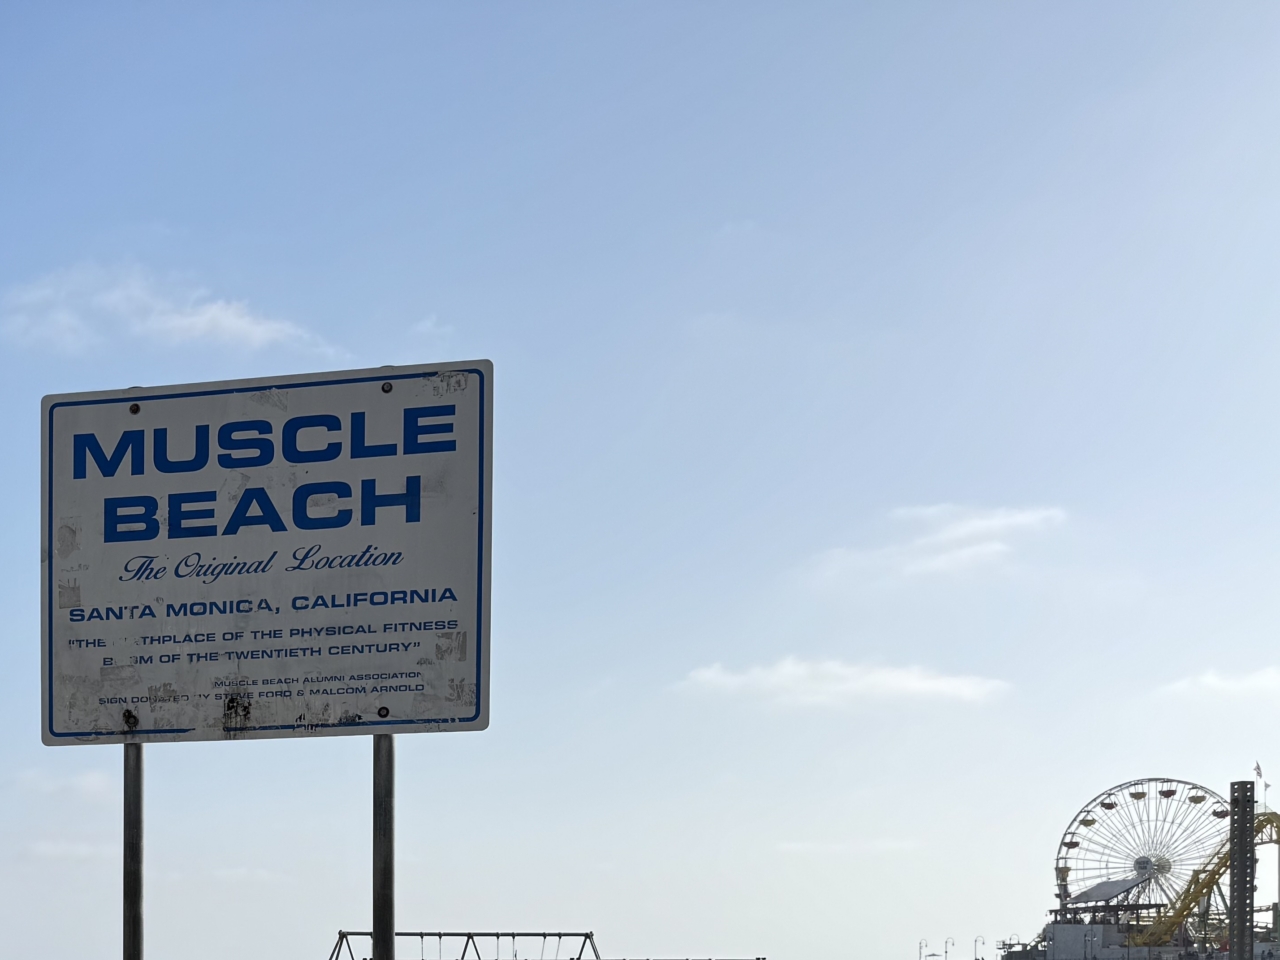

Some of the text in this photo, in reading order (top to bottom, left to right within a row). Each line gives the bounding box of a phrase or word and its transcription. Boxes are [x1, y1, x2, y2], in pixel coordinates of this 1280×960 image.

[73, 404, 456, 479] MUSCLE
[104, 475, 420, 543] BEACH
[119, 544, 404, 584] The Original Location
[69, 588, 458, 622] SANTA MONICA, CALIFORNIA
[112, 632, 216, 647] THPLACE
[222, 631, 245, 642] OF
[250, 629, 283, 640] THE
[289, 625, 377, 638] PHYSICAL
[383, 620, 458, 633] FITNESS
[159, 653, 181, 664] OF
[186, 651, 219, 663] THE
[224, 647, 322, 661] TWENTIETH
[98, 696, 127, 705] SIGN
[215, 691, 254, 700] STEVE
[258, 689, 292, 698] FORD
[296, 689, 305, 697] &
[309, 685, 367, 696] MALCOM
[370, 683, 425, 693] ARNOLD
[262, 677, 299, 686] BEACH
[303, 674, 345, 683] ALUMNI
